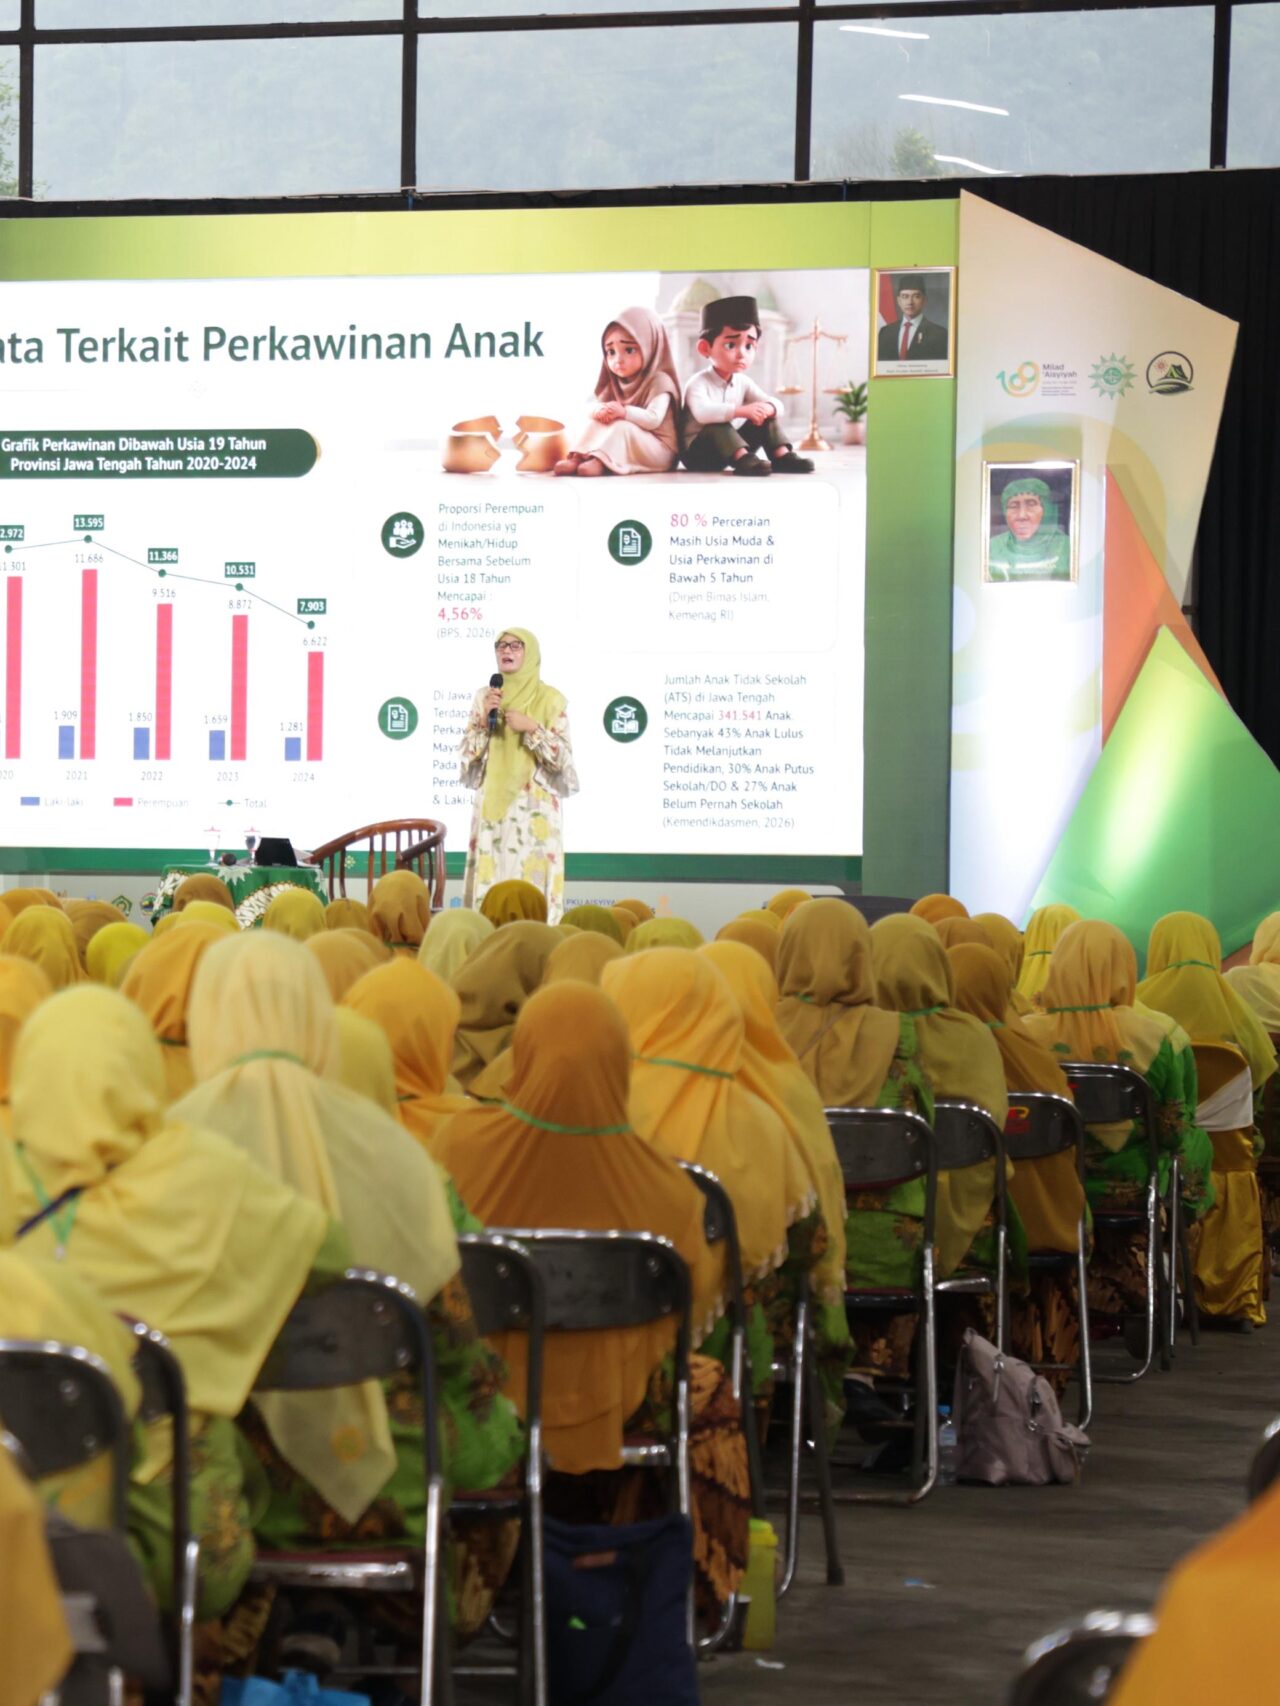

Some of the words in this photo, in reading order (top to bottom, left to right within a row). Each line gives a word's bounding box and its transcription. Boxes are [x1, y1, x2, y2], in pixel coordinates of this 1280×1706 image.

[56, 326, 189, 364] Terkait
[203, 324, 431, 362] Perkawinan
[444, 322, 544, 359] Anak
[1, 438, 39, 452] Grafik
[42, 438, 116, 452] Perkawinan
[118, 437, 174, 451] Dibawah
[177, 437, 205, 451] Usia
[209, 436, 225, 450] 19
[228, 436, 266, 450] Tahun
[10, 457, 61, 471] Provinsi
[63, 458, 94, 471] Jawa
[96, 457, 142, 474] Tengah
[144, 456, 183, 470] Tahun
[186, 456, 257, 470] 2020-2024
[438, 503, 482, 516] Proporsi
[485, 502, 544, 516] Perempuan
[74, 517, 104, 530] 13.595
[670, 513, 689, 528] 80
[694, 513, 708, 527] %
[712, 516, 770, 528] Perceraian
[438, 521, 448, 532] di
[451, 520, 502, 532] Indonesia
[504, 522, 517, 534] yg
[438, 538, 518, 550] Menikah/Hidup
[670, 536, 702, 546] Masih
[705, 536, 728, 546] Usia
[732, 536, 762, 546] Muda
[766, 536, 775, 546] &
[149, 551, 178, 561] 11.366
[438, 555, 482, 566] Bersama
[485, 554, 531, 566] Sebelum
[669, 554, 693, 566] Usia
[696, 554, 760, 566] Perkawinan
[763, 554, 774, 565] di
[224, 565, 254, 578] 10.531
[438, 574, 460, 584] Usia
[464, 572, 476, 584] 18
[479, 572, 511, 584] Tahun
[669, 572, 706, 584] Bawah
[710, 572, 716, 583] 5
[720, 572, 753, 583] Tahun
[437, 591, 486, 602] Mencapai
[300, 601, 324, 612] 7.903
[438, 606, 484, 622] 4,56%
[668, 610, 717, 622] Kemenag
[466, 626, 496, 640] 2026)
[664, 674, 701, 685] Jumlah
[704, 674, 730, 685] Anak
[733, 674, 762, 685] Tidak
[764, 674, 807, 686] Sekolah
[433, 690, 444, 702] Di
[448, 691, 472, 701] Jawa
[664, 692, 692, 705] (ATS)
[694, 692, 705, 702] di
[708, 692, 734, 703] Jawa
[736, 692, 776, 706] Tengah
[664, 710, 714, 722] Mencapai
[718, 710, 761, 721] 341.541
[664, 728, 714, 740] Sebanyak
[717, 728, 742, 738] 43%
[744, 728, 771, 739] Anak
[774, 728, 804, 739] Lulus
[664, 744, 692, 756] Tidak
[696, 744, 762, 758] Melanjutkan
[432, 760, 458, 770] Pada
[663, 762, 724, 775] Pendidikan,
[728, 762, 752, 774] 30%
[754, 763, 781, 774] Anak
[784, 762, 814, 775] Putus
[66, 770, 88, 781] 2021
[140, 770, 163, 782] 2022
[216, 771, 239, 782] 2023
[292, 772, 315, 782] 2024
[663, 780, 727, 792] Sekolah/DO
[730, 780, 739, 792] &
[744, 780, 768, 792] 27%
[770, 780, 797, 792] Anak
[136, 796, 189, 809] Perempuan
[244, 798, 267, 808] Total
[432, 794, 440, 806] &
[444, 794, 476, 806] Laki-L
[662, 798, 697, 809] Belum
[700, 798, 738, 810] Pernah
[740, 798, 783, 810] Sekolah
[764, 816, 795, 830] 2026)
